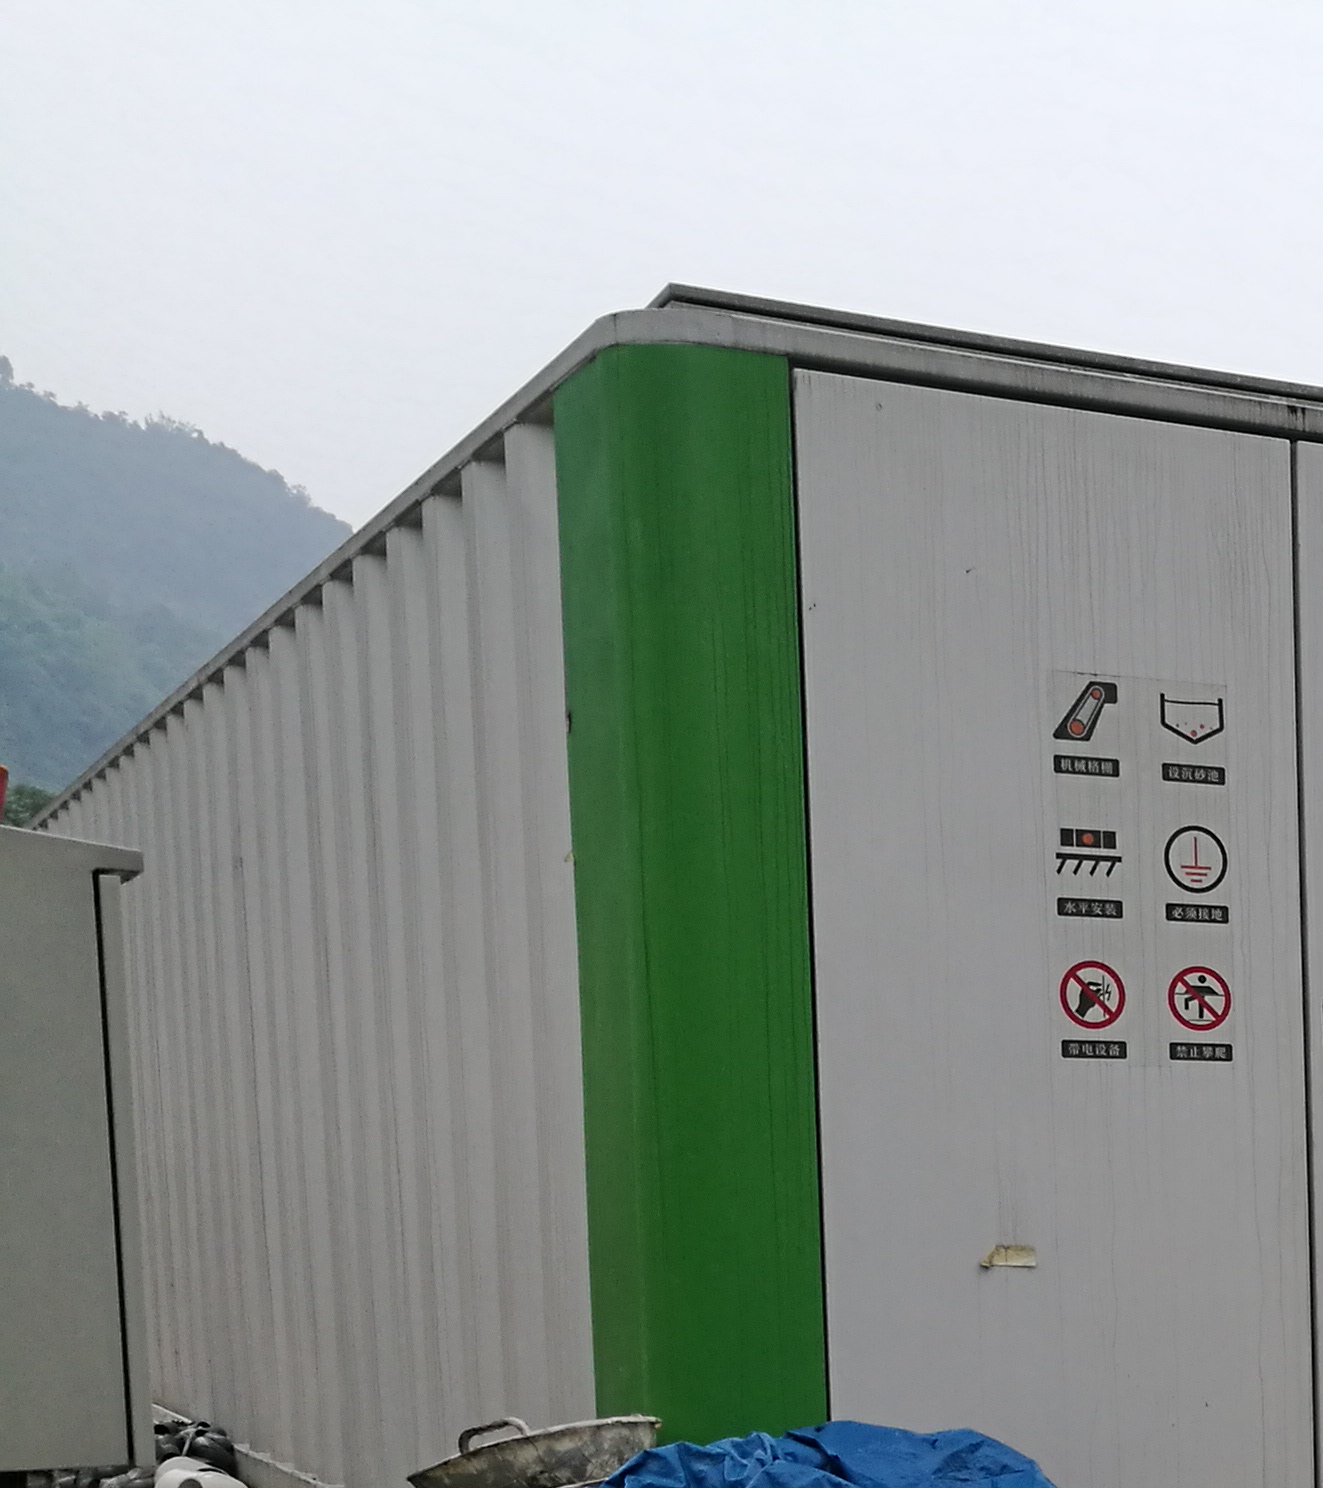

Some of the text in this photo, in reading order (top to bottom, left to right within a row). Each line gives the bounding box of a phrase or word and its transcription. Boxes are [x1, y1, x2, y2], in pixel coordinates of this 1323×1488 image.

[1060, 757, 1114, 775] 机械格栅
[1168, 765, 1220, 782] 设沉砂池
[1063, 901, 1118, 916] 水平安装
[1171, 906, 1223, 921] 必须接地
[1068, 1043, 1121, 1056] 带电设备
[1176, 1045, 1227, 1059] 禁止攀爬
